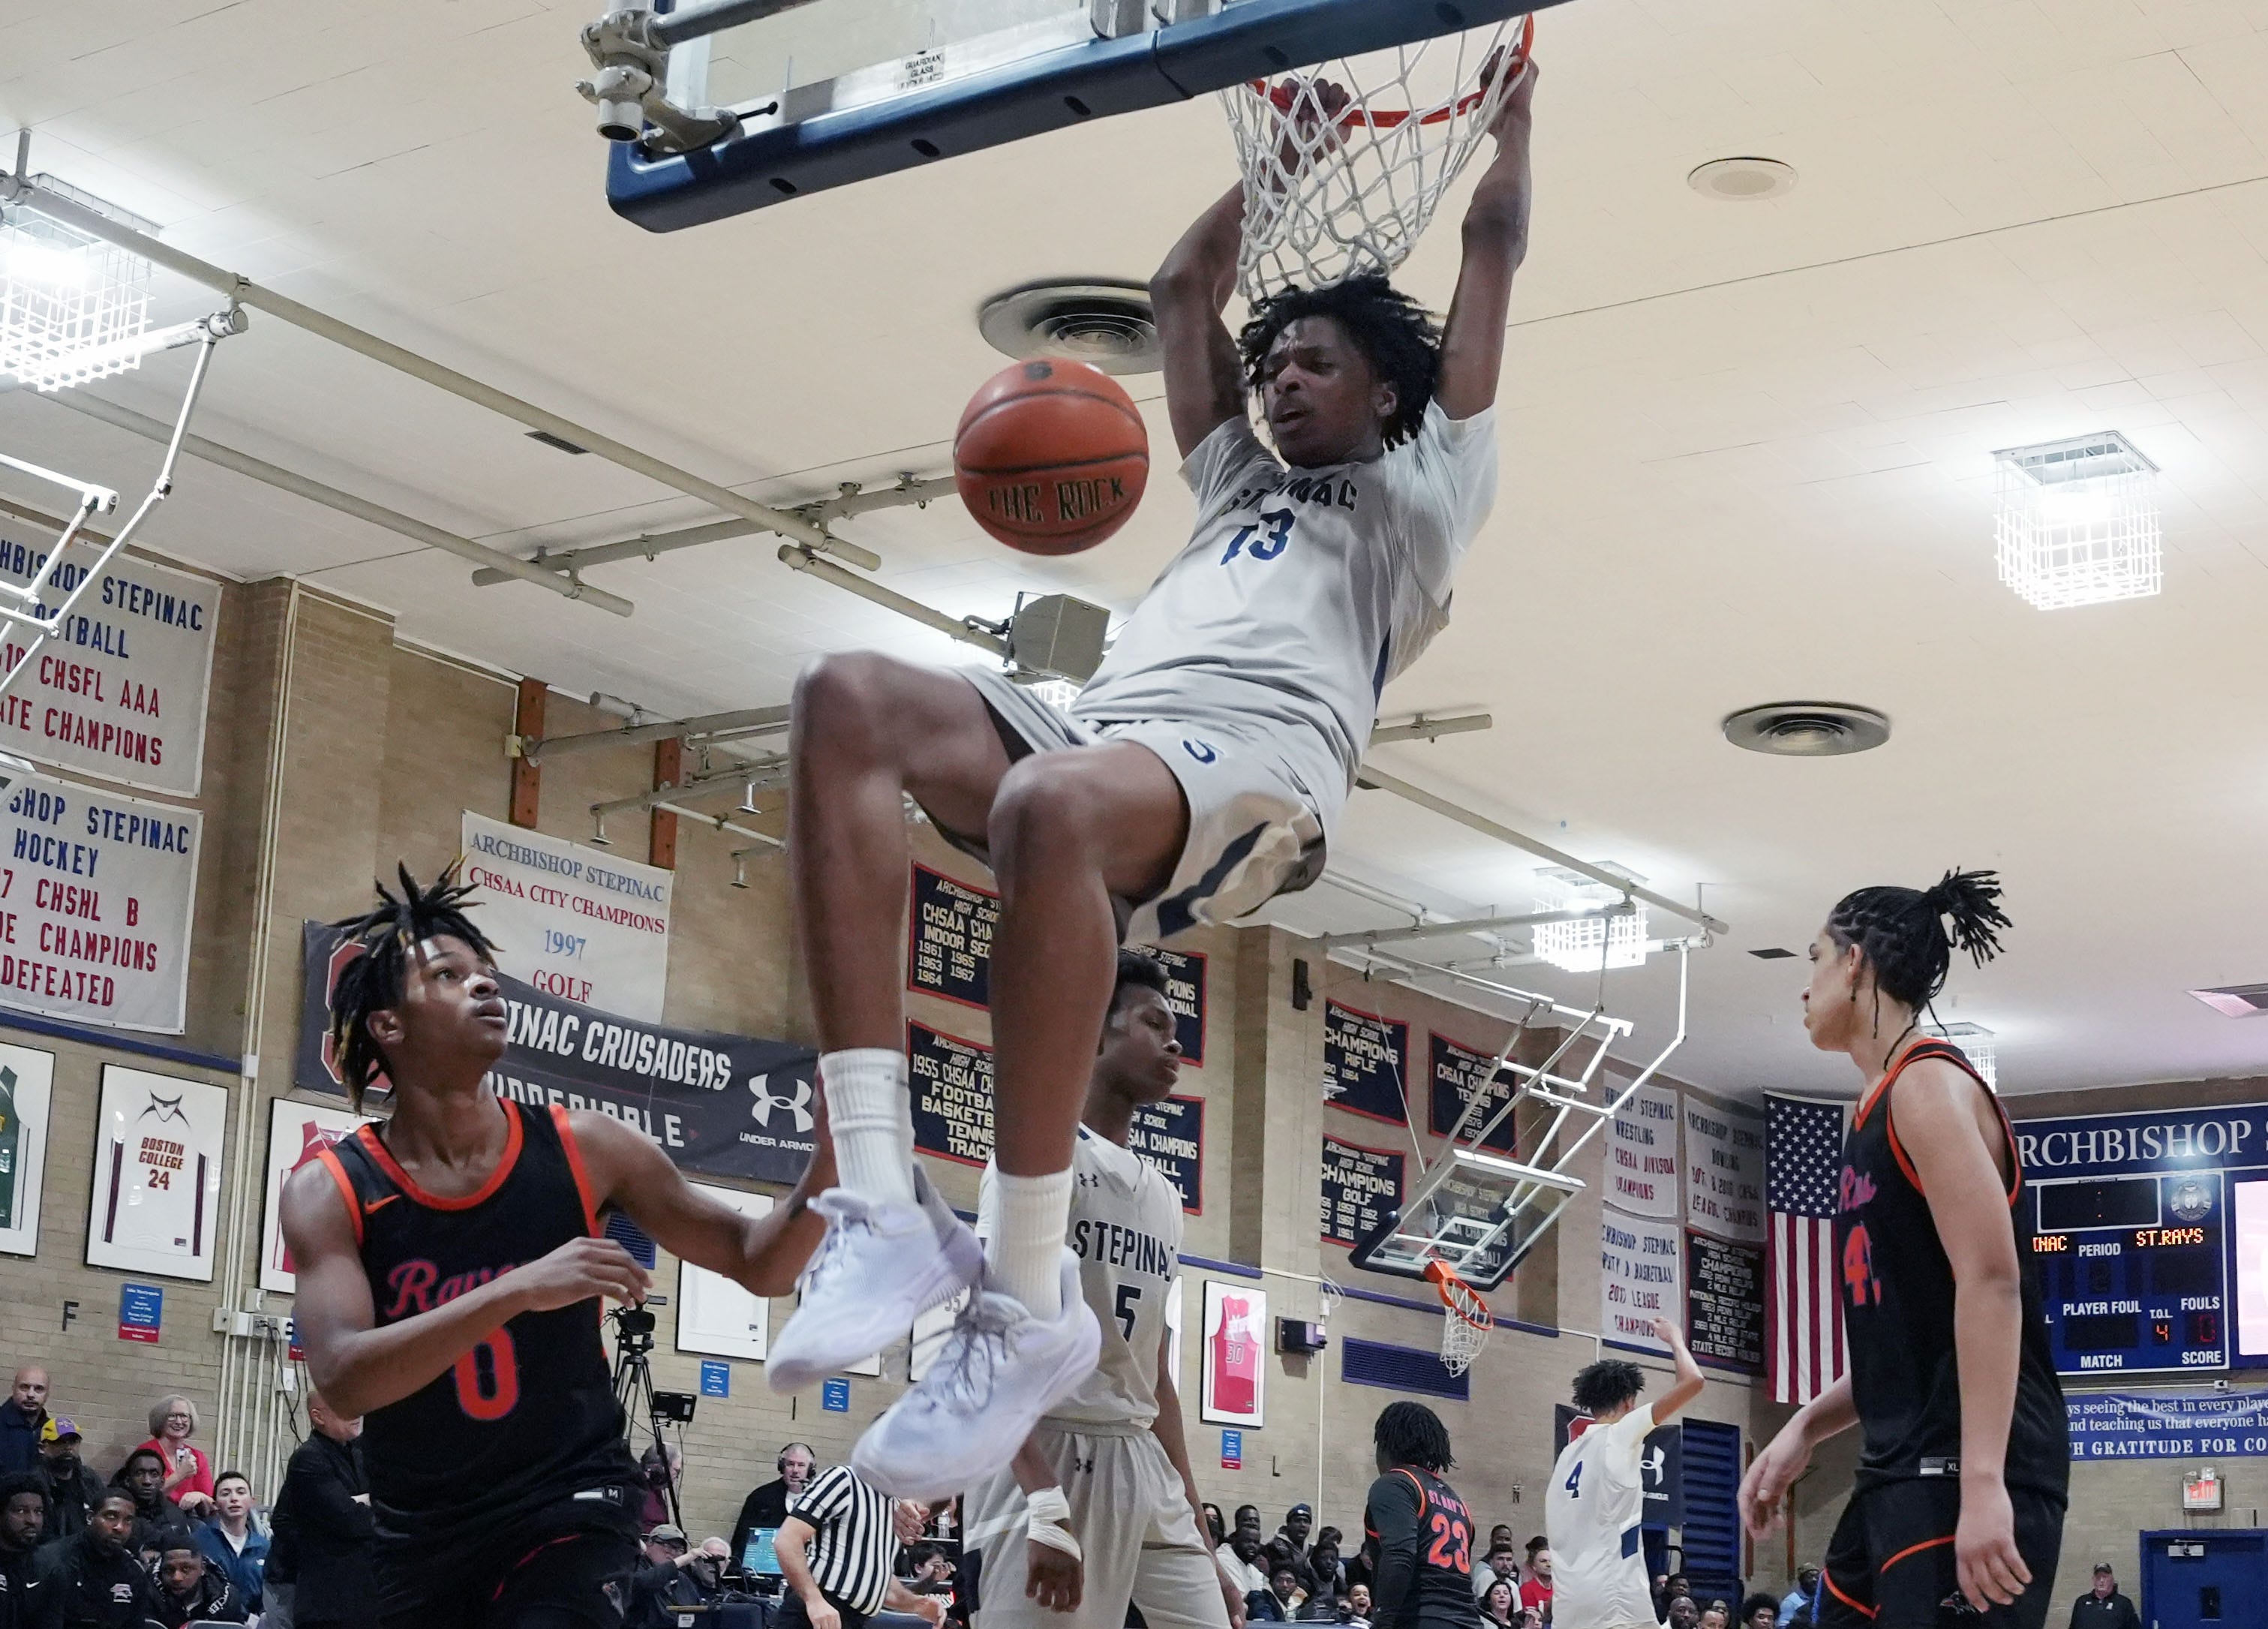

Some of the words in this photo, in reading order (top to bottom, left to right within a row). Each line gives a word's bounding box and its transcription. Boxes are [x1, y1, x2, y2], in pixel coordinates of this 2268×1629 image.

[985, 484, 1044, 522] THE
[1056, 477, 1124, 521] ROCK
[1220, 508, 1296, 566] 13
[102, 576, 203, 630] STEPINAC
[40, 656, 104, 702] CHSFL
[120, 680, 159, 718] AAA
[44, 708, 162, 765] CHAMPIONS
[88, 807, 189, 854] STEPINAC
[14, 828, 98, 878] HOCKEY
[471, 833, 582, 878] ARCHBISHOP
[586, 867, 664, 901] STEPINAC
[36, 879, 101, 921] CHSHL
[127, 897, 139, 927] B
[470, 867, 524, 898] CHSAA
[530, 885, 569, 908] CITY
[572, 897, 665, 933] CHAMPIONS
[954, 900, 973, 915] HIGH
[923, 902, 965, 933] CHSAA
[41, 922, 158, 972] CHAMPIONS
[545, 930, 587, 960] 1997
[924, 924, 965, 951] INDOOR
[918, 940, 942, 958] 1961
[951, 950, 975, 968] 1965
[918, 954, 942, 972] 1963
[951, 965, 975, 982] 1967
[1, 954, 114, 1006] DEFEATED
[533, 969, 593, 1003] GOLF
[917, 968, 942, 986] 1964
[498, 997, 580, 1056] INAC
[581, 1021, 731, 1091] CRUSADERS
[1324, 1026, 1399, 1065] CHAMPIONS
[913, 1053, 939, 1078] 1955
[942, 1063, 975, 1090] CHSAA
[949, 1053, 971, 1067] HIGH
[1344, 1052, 1377, 1074] RIFLE
[141, 1137, 185, 1156] BOSTON
[739, 1132, 776, 1147] UNDER
[779, 1140, 815, 1151] ARMO
[946, 1120, 995, 1146] TENNIS
[1150, 1133, 1198, 1160] CHAMPIONS
[2017, 1120, 2251, 1168] RCHBISHOP
[139, 1150, 184, 1170] COLLEGE
[149, 1168, 170, 1190] 24
[1321, 1162, 1395, 1197] CHAMPIONS
[1343, 1188, 1373, 1206] GOLF
[1073, 1219, 1175, 1282] STEPINA
[2078, 1243, 2121, 1257] PERIOD
[1115, 1284, 1141, 1342] 5
[1632, 1290, 1660, 1309] LEAGUE
[2063, 1303, 2107, 1315] PLAYER
[2112, 1300, 2142, 1314] FOUL
[2181, 1297, 2220, 1310] FOULS
[62, 1301, 79, 1331] F
[2155, 1324, 2168, 1341] 4
[1226, 1342, 1244, 1364] 30
[2080, 1355, 2122, 1369] MATCH
[2182, 1351, 2222, 1365] SCORE
[2083, 1400, 2125, 1416] seeing
[2128, 1400, 2149, 1413] the
[2152, 1399, 2179, 1412] best
[2182, 1399, 2197, 1411] in
[2199, 1400, 2234, 1414] every
[2068, 1417, 2086, 1432] nd
[2089, 1417, 2146, 1433] teaching
[2147, 1420, 2161, 1429] us
[2165, 1417, 2193, 1429] that
[2195, 1417, 2254, 1430] everyone
[2071, 1442, 2084, 1456] H
[2092, 1439, 2194, 1455] GRATITUDE
[2201, 1438, 2236, 1453] FOR
[2244, 1438, 2267, 1451] CO
[1566, 1460, 1582, 1498] 4
[1948, 1462, 1959, 1471] XL
[2189, 1480, 2215, 1499] EXIT
[1428, 1512, 1470, 1574] 23
